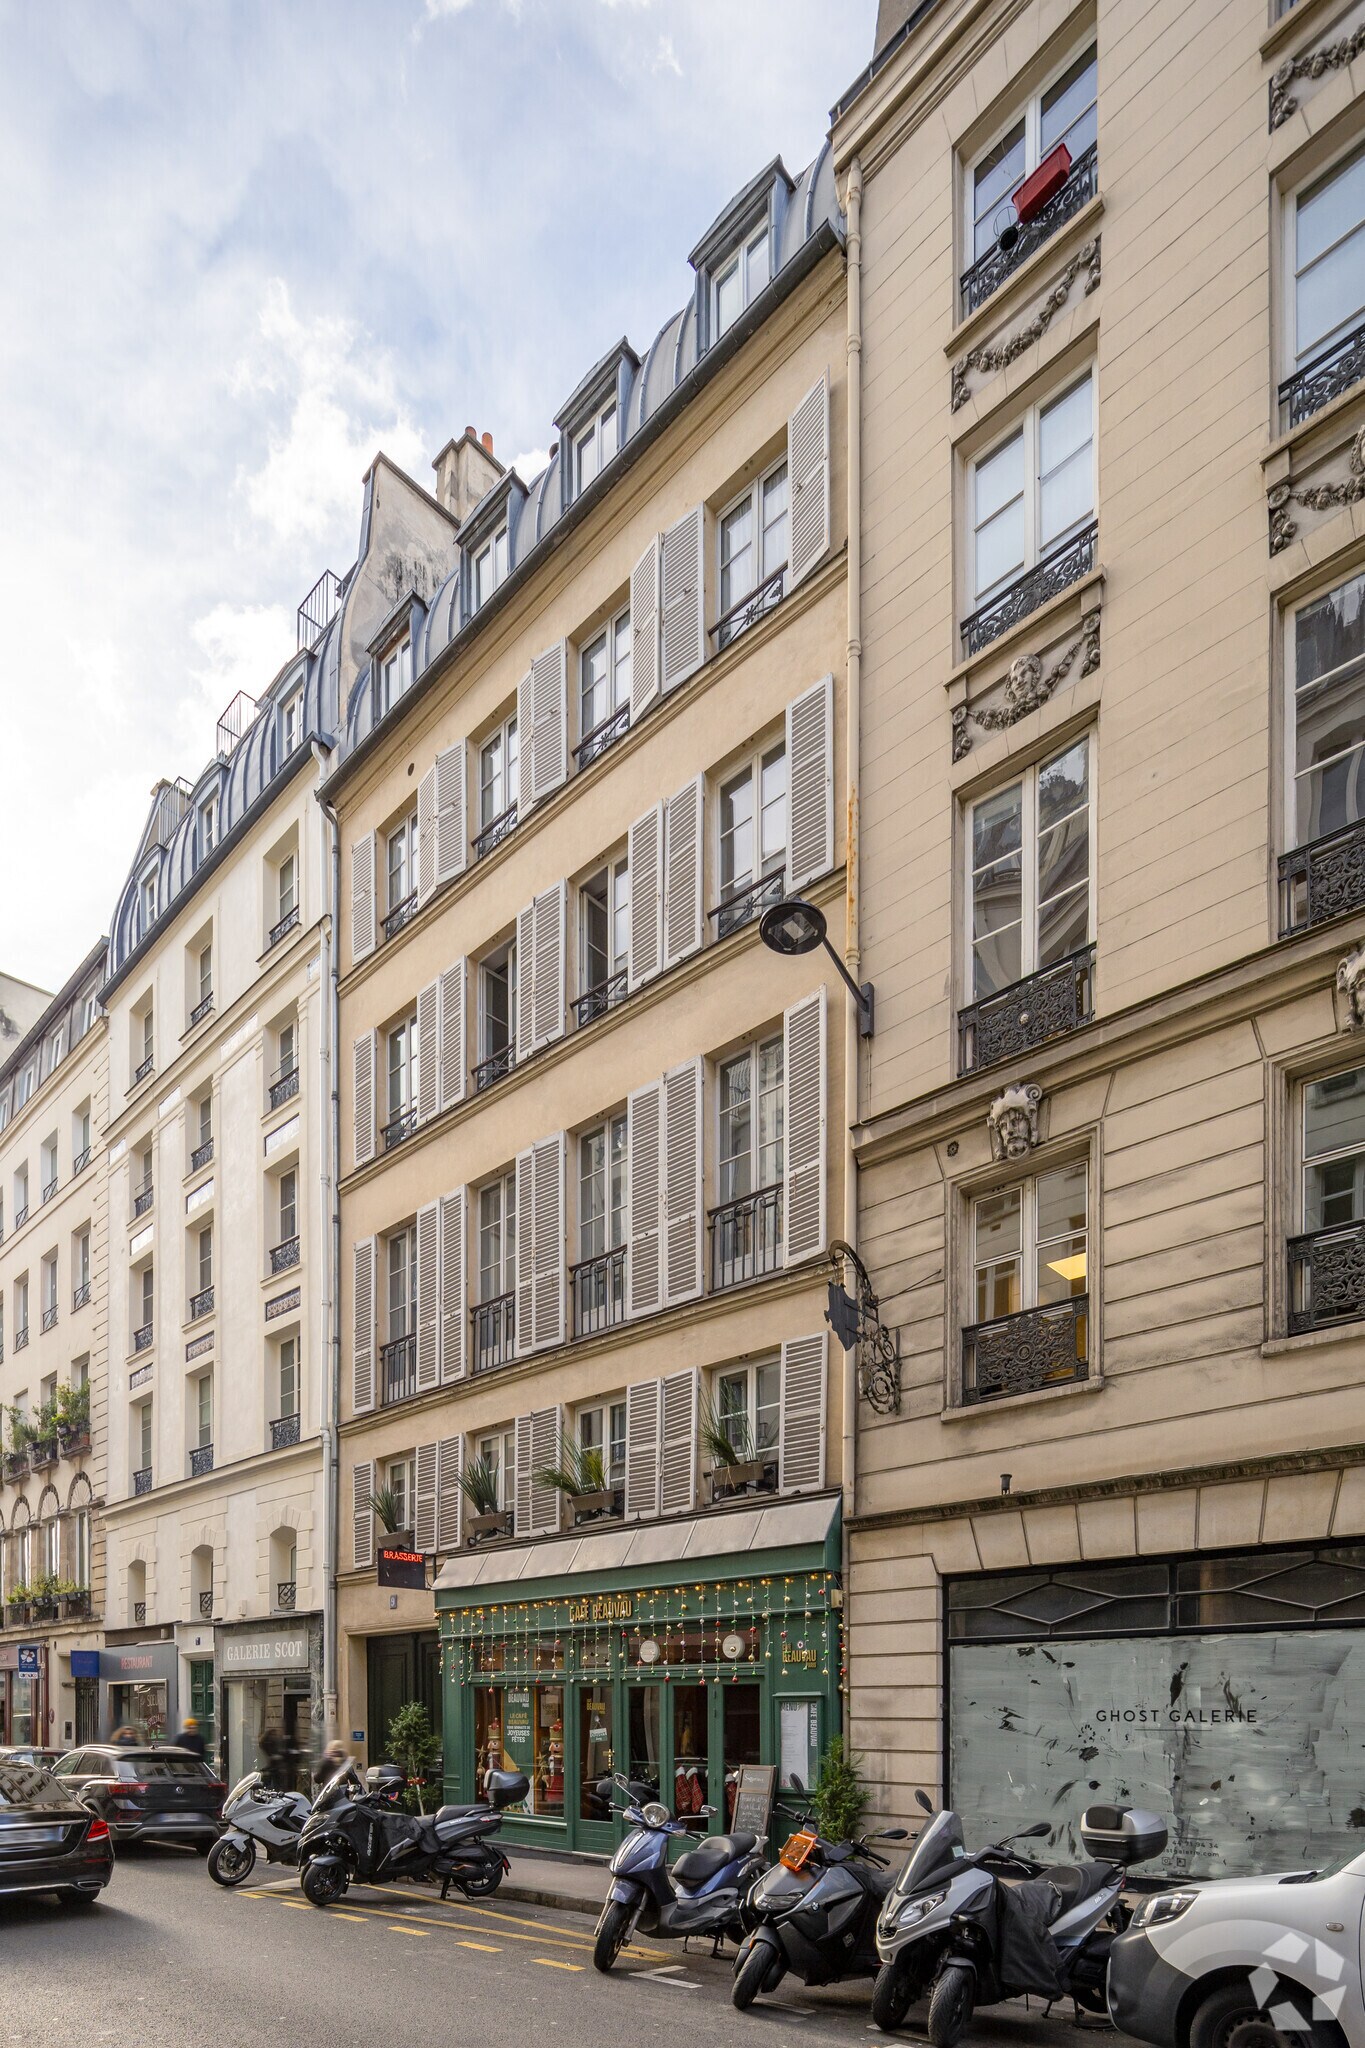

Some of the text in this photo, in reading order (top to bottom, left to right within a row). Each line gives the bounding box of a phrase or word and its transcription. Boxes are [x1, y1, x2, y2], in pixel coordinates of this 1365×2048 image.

[383, 1550, 423, 1563] BRASSERIE
[592, 1600, 632, 1620] BEAUVAU
[226, 1640, 303, 1661] GALERIE SCOT
[120, 1655, 153, 1670] RESTAURANT
[1096, 1709, 1258, 1723] GHOST GALERIE
[810, 1719, 818, 1747] BEAUVAU
